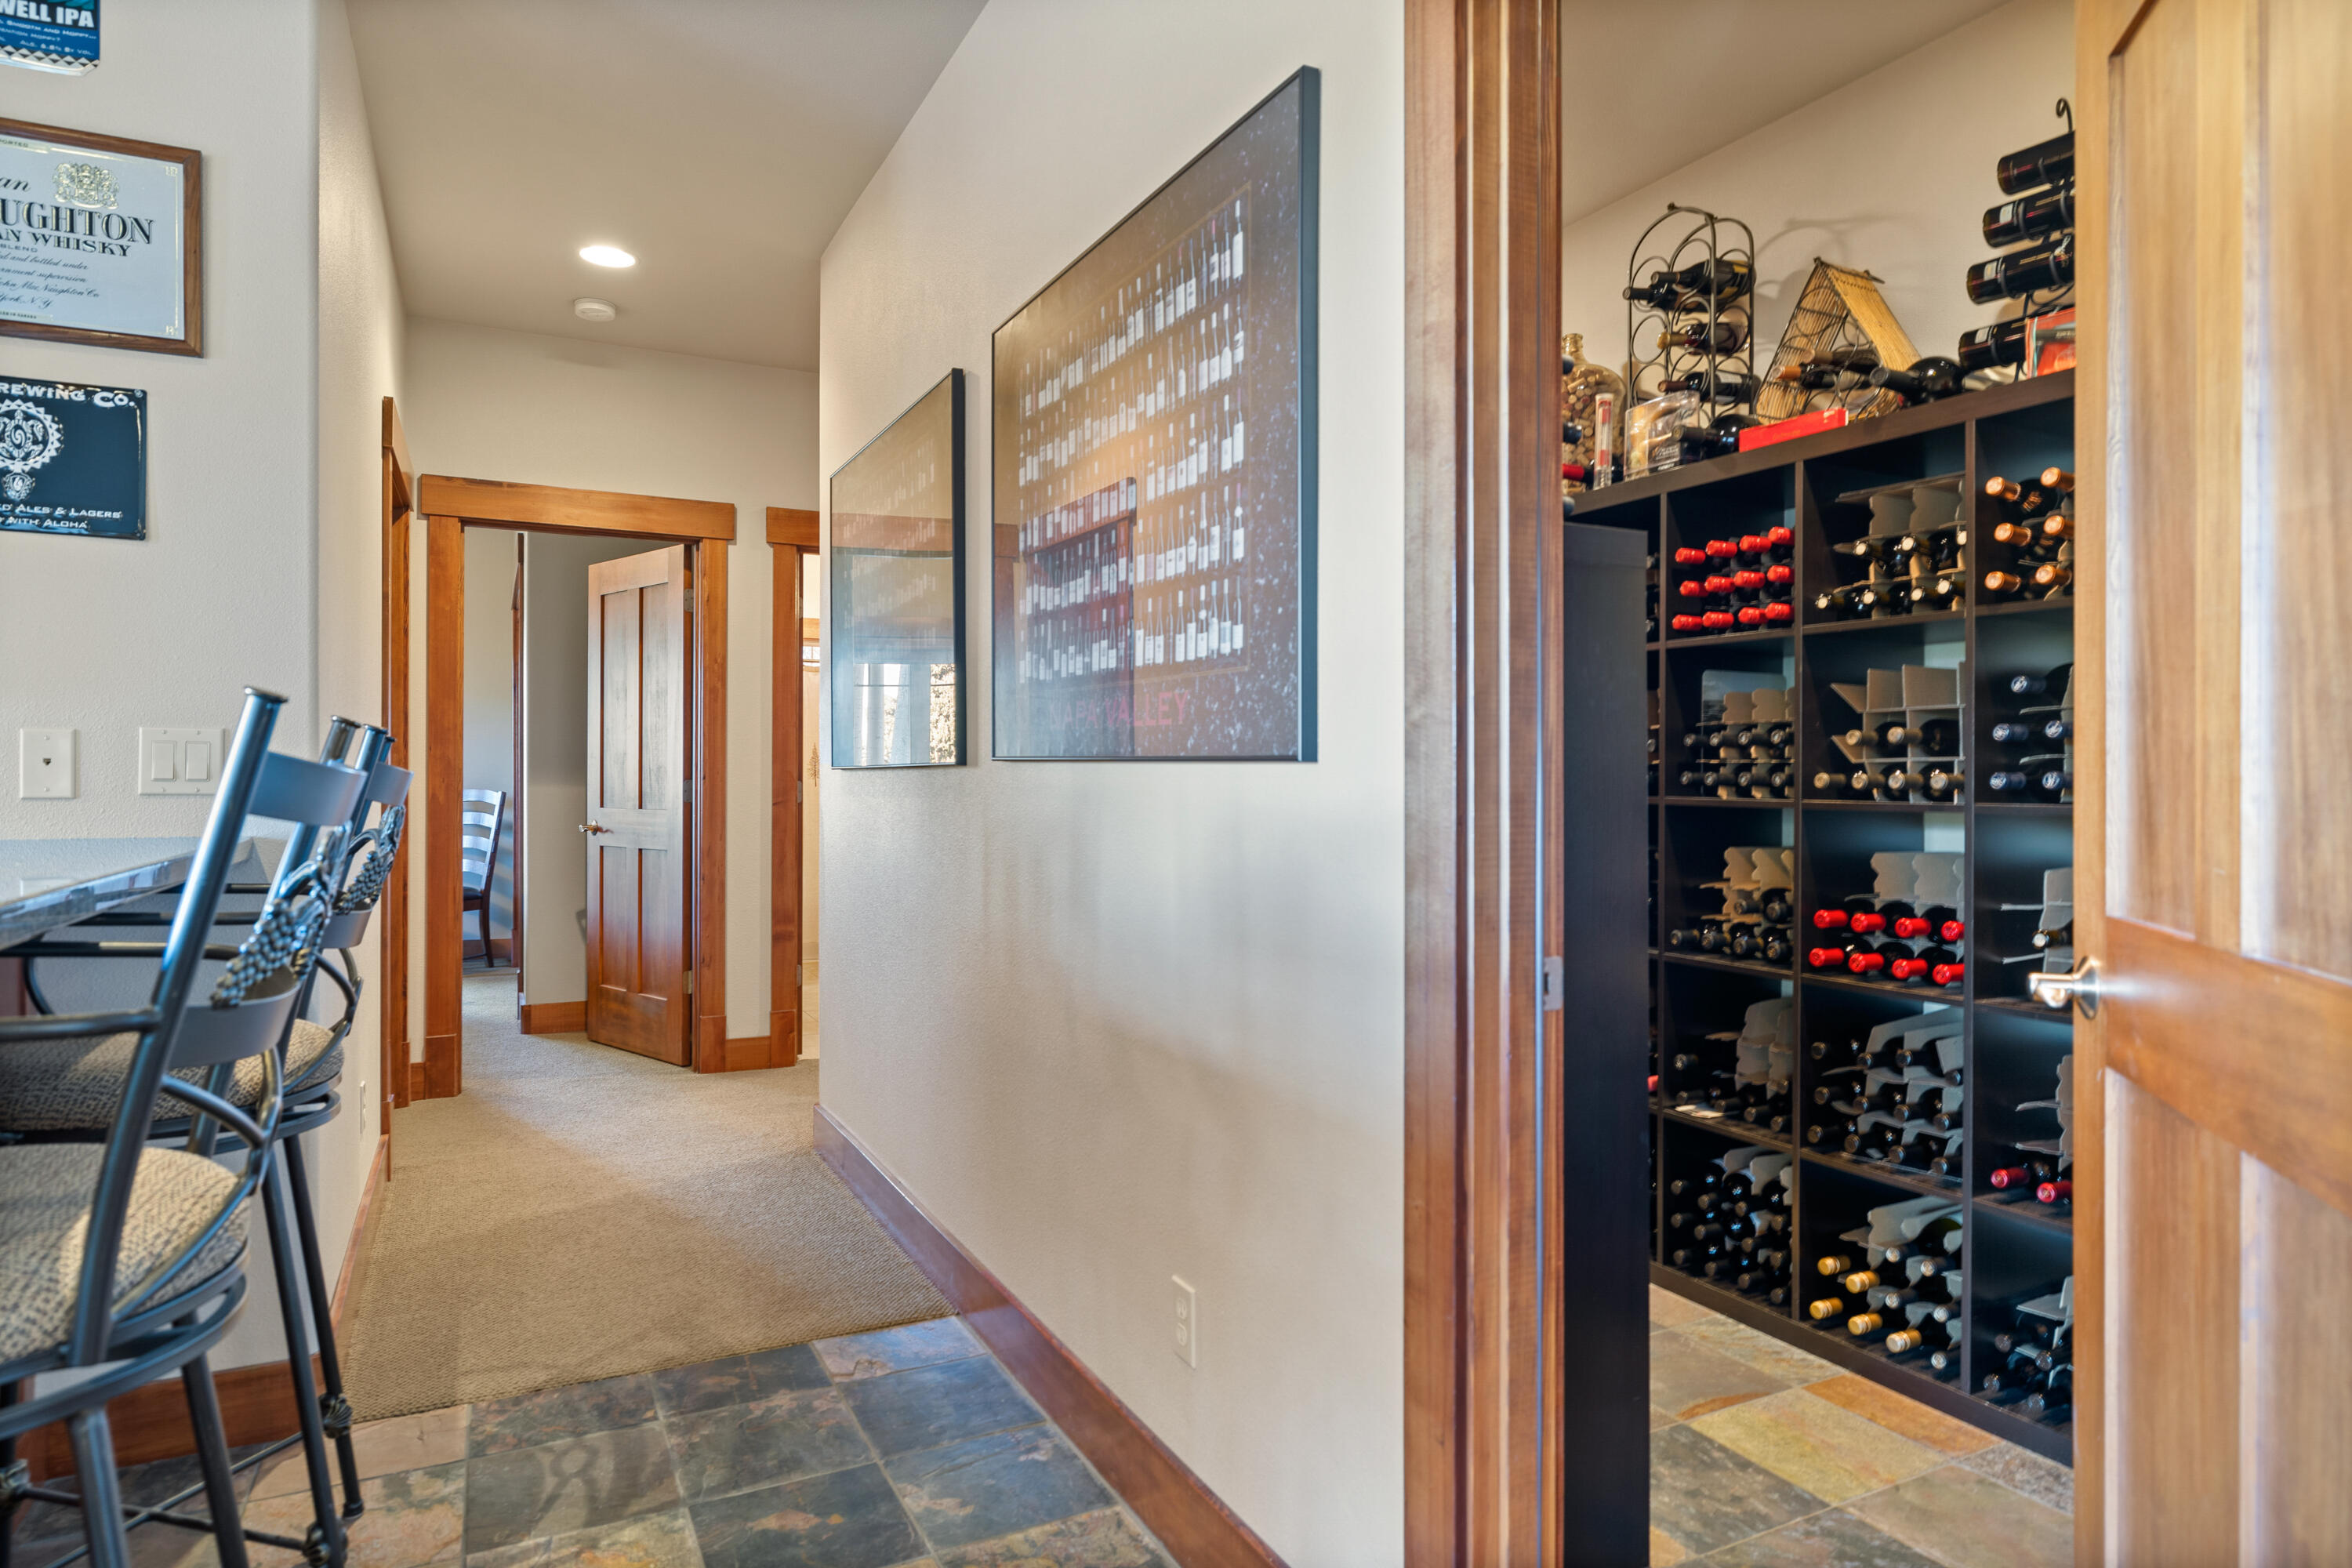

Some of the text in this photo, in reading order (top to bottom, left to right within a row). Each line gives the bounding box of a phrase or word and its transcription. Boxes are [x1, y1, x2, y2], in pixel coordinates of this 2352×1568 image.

[56, 6, 94, 27] IPA
[0, 138, 29, 147] ORTED
[0, 199, 156, 244] UGHTON
[0, 243, 38, 252] BLEND
[27, 231, 132, 257] WHISKY
[10, 254, 31, 263] and
[30, 256, 62, 267] bottled
[63, 261, 88, 270] under
[37, 272, 86, 281] supervision
[1049, 690, 1189, 729] NAPA VALLEY
